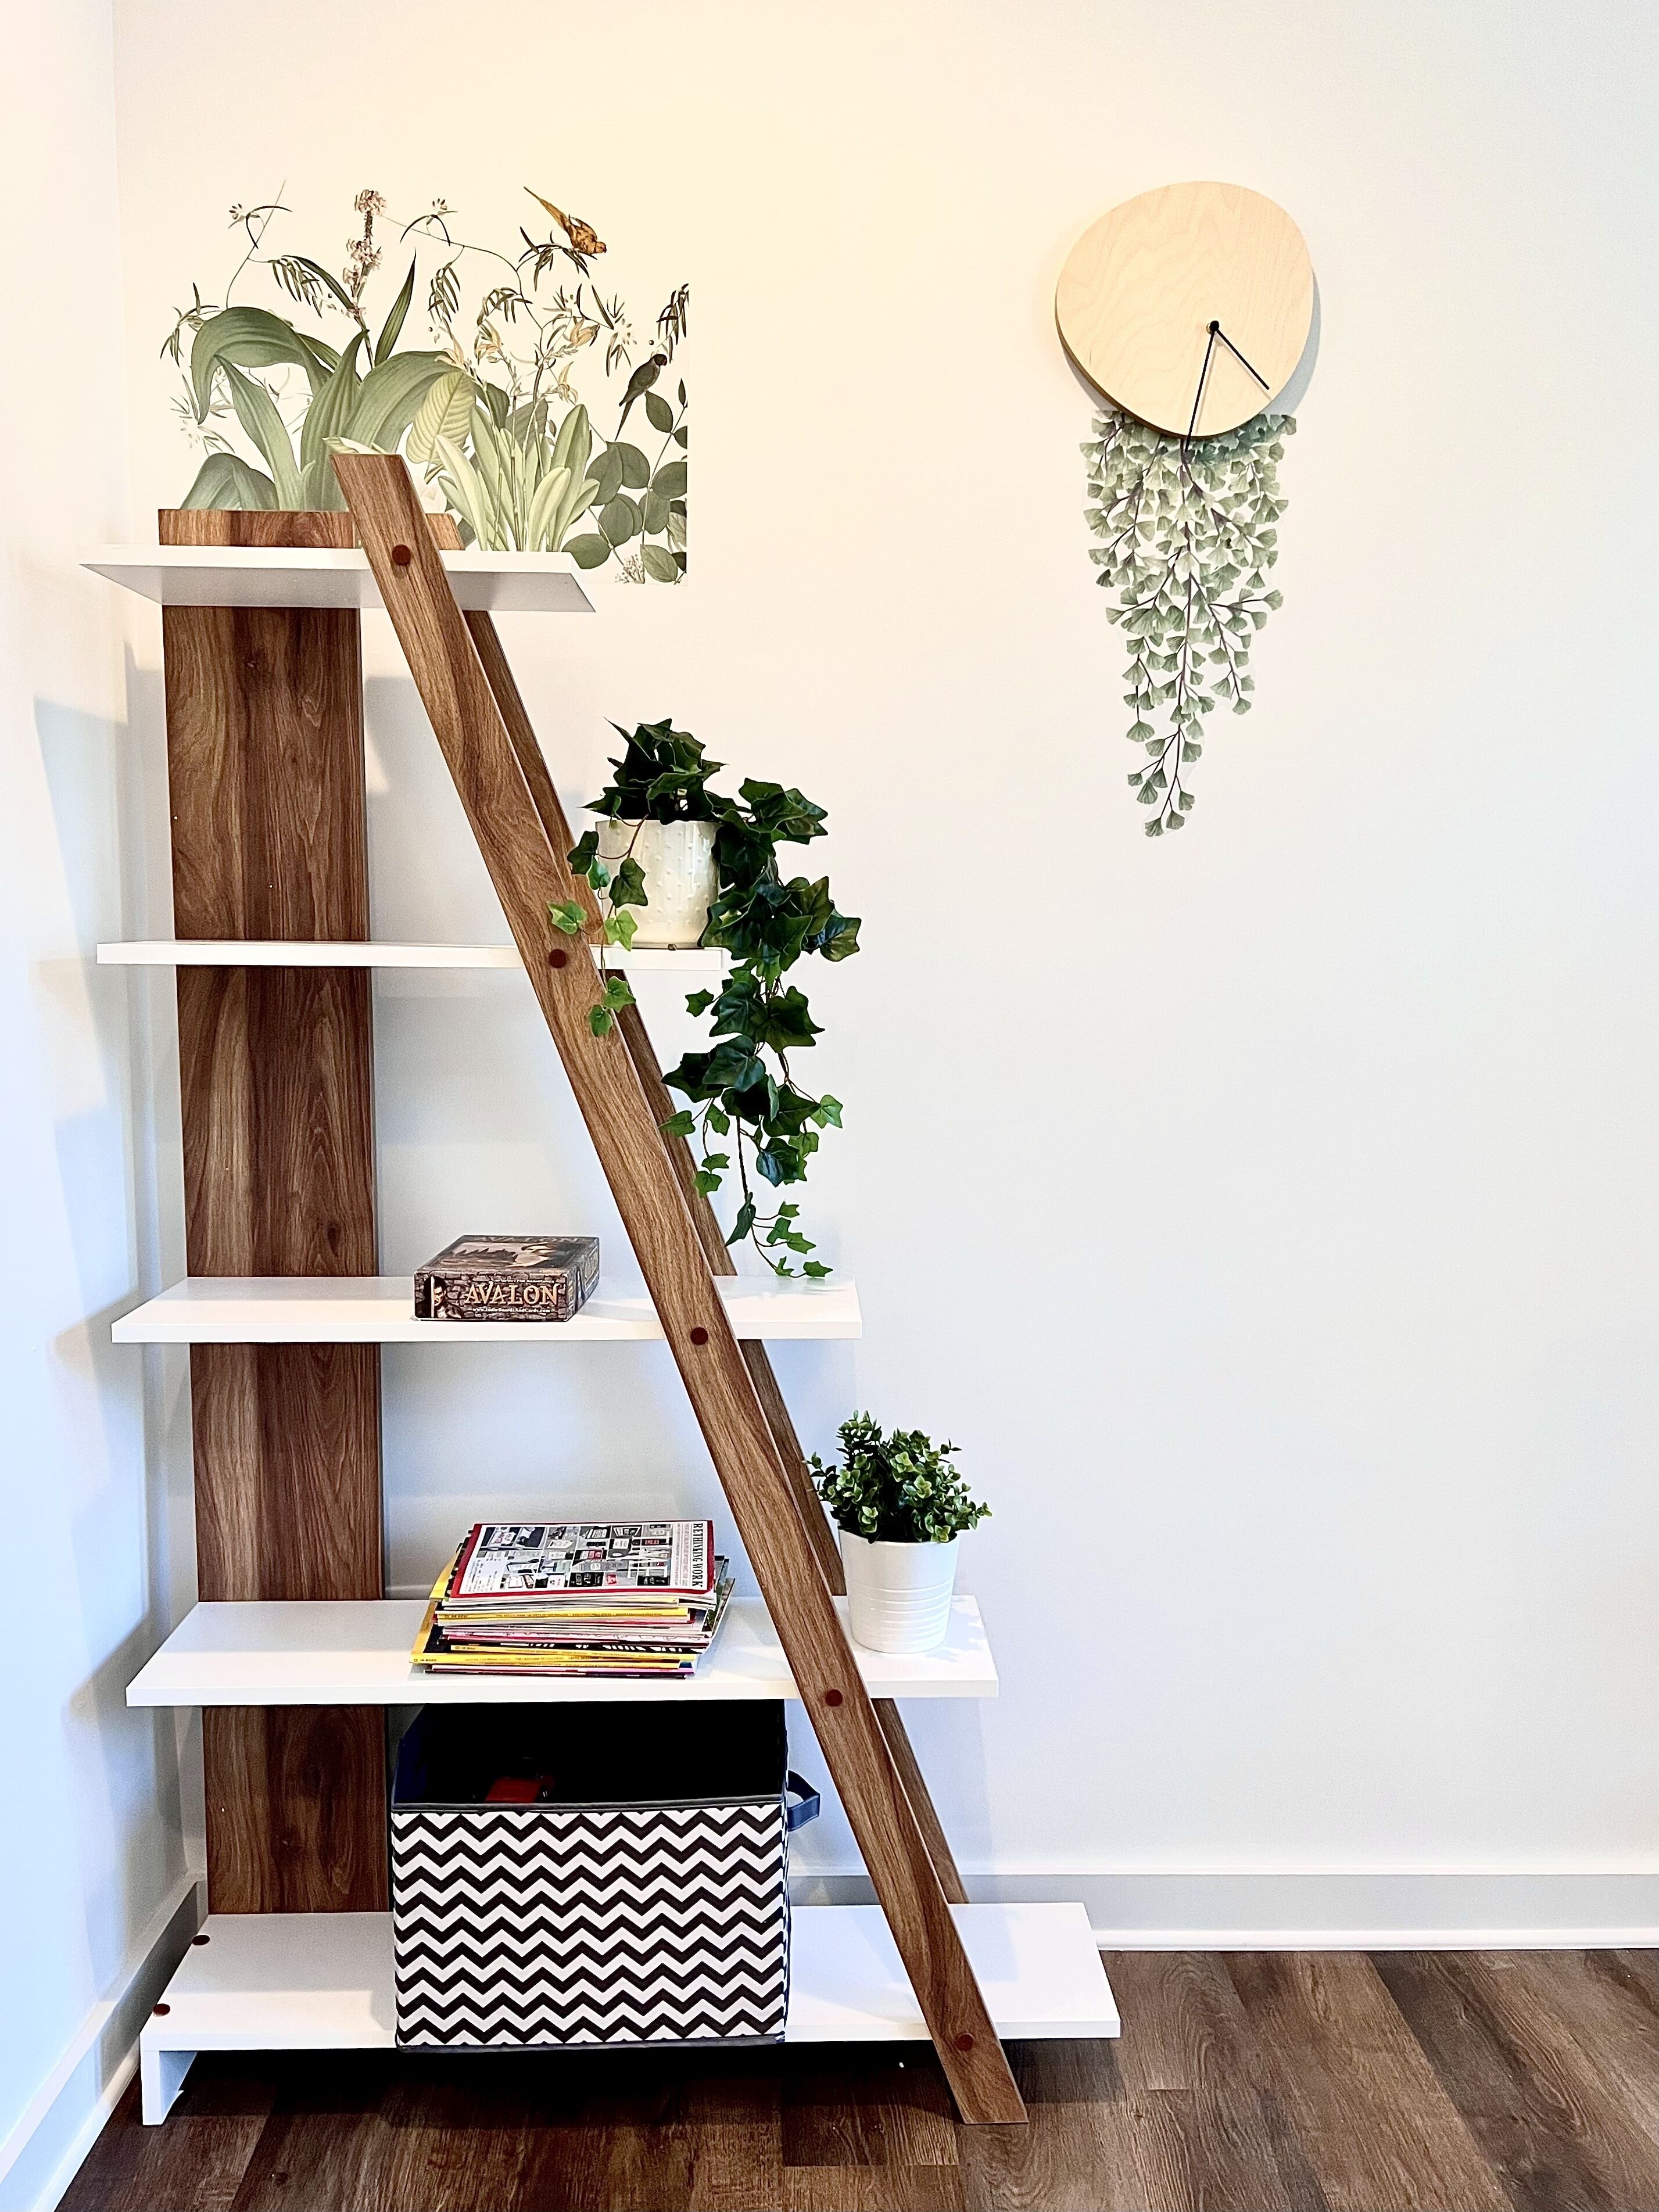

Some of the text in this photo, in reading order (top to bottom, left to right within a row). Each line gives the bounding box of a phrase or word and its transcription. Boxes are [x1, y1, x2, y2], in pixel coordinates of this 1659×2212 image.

[464, 1281, 561, 1306] AVALON
[691, 1523, 704, 1587] RETHINKING WORK
